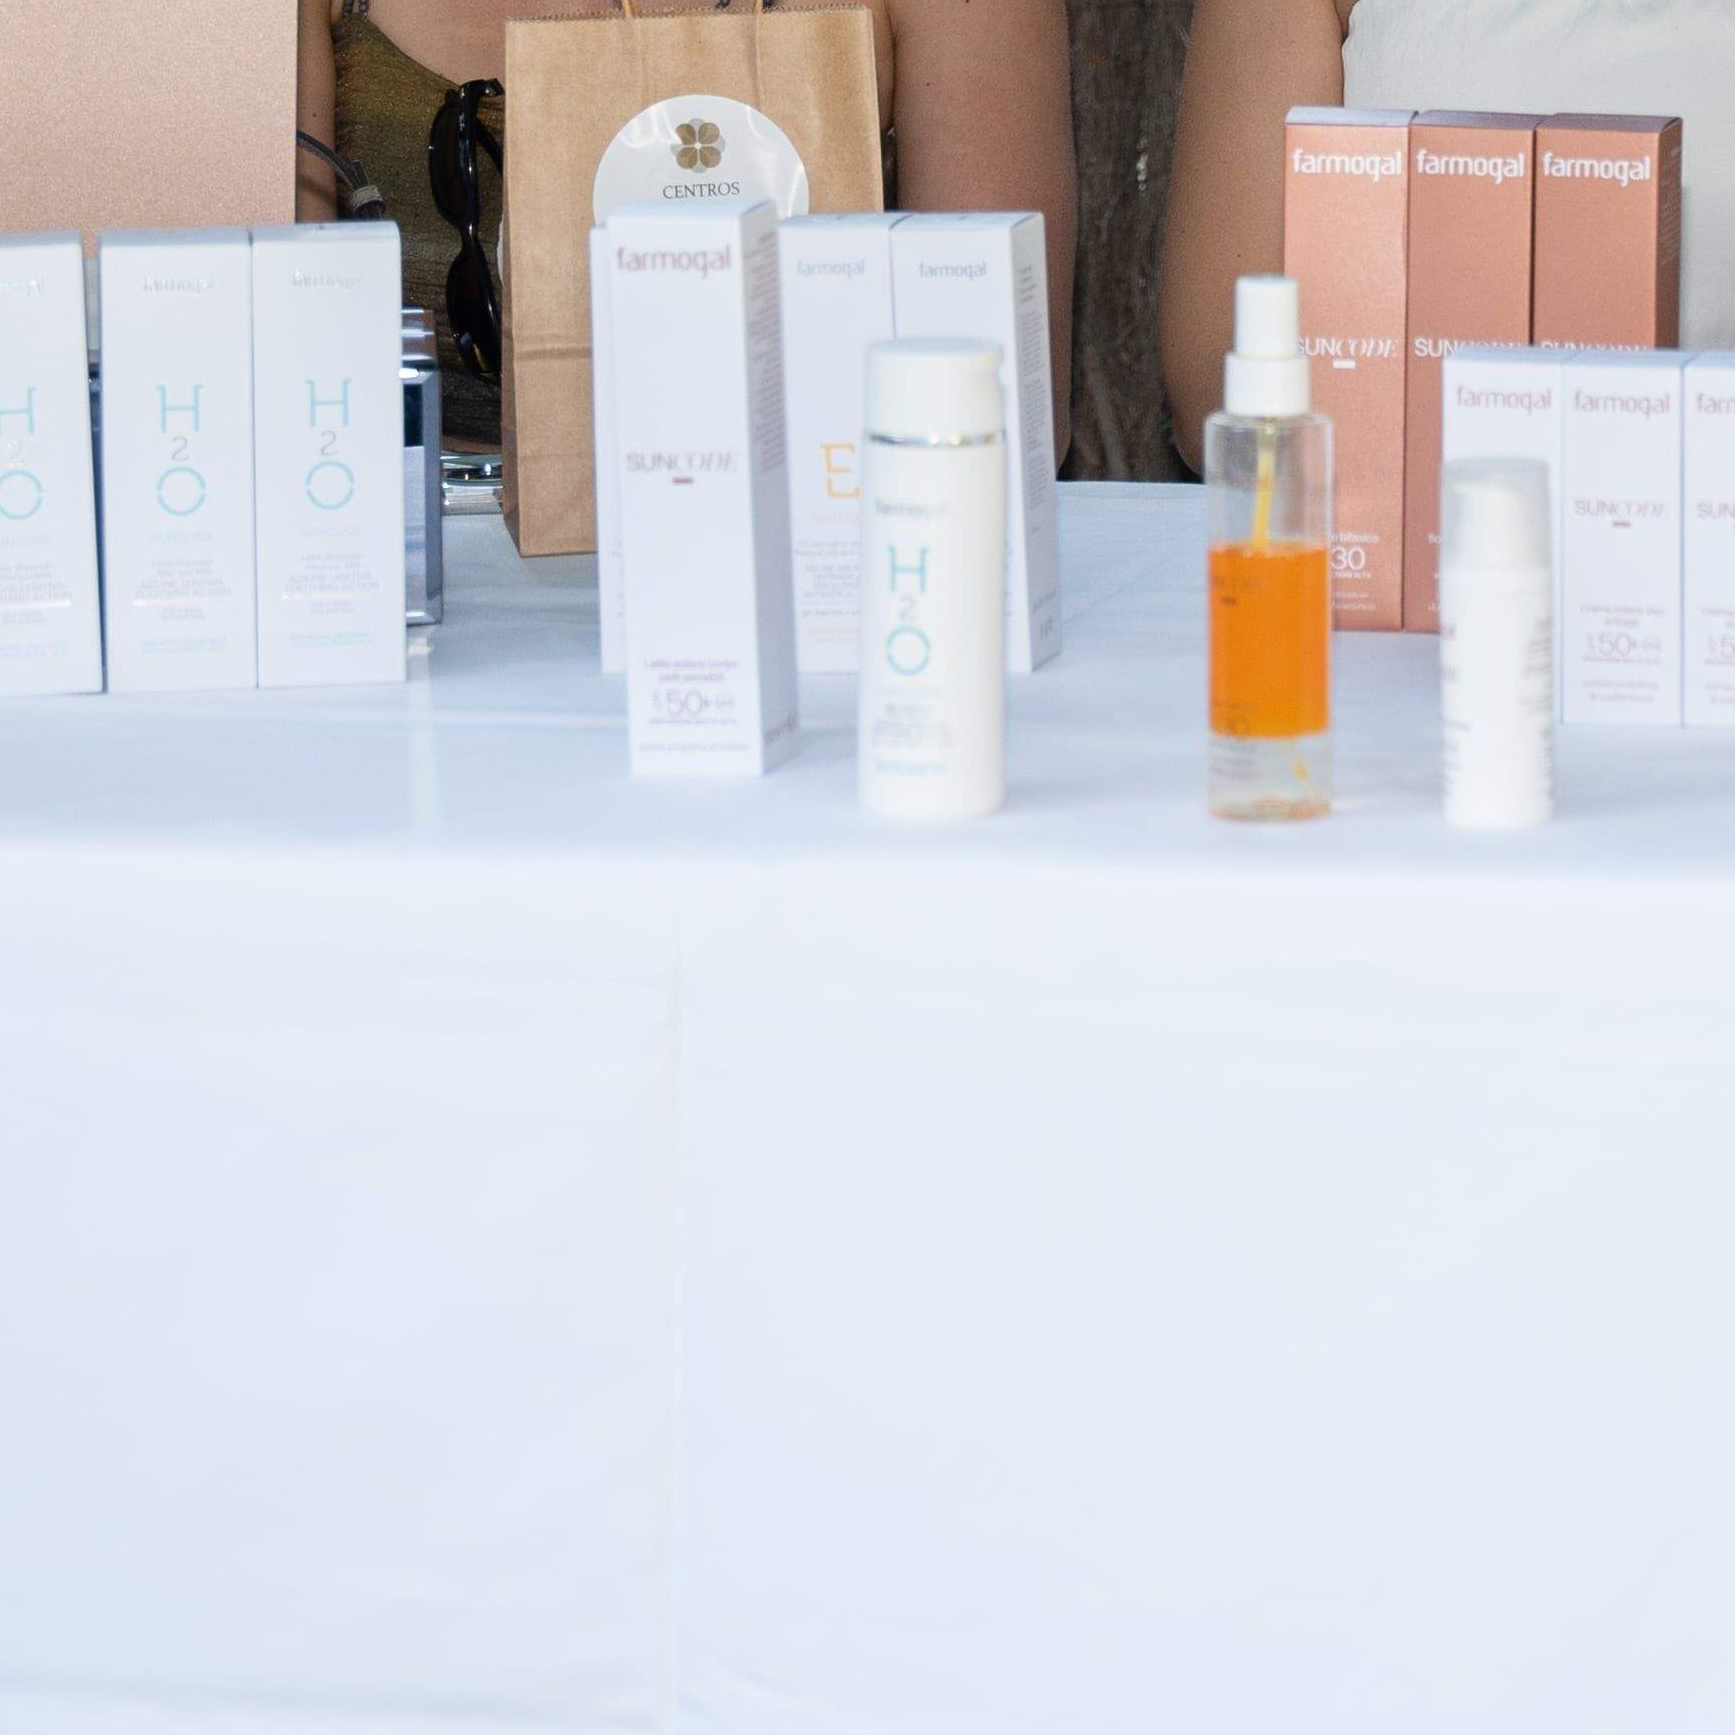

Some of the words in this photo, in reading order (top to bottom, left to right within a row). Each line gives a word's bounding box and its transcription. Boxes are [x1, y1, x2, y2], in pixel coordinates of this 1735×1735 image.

[1292, 148, 1403, 182] farmogal
[1416, 149, 1526, 185] farmogal
[1542, 151, 1652, 187] farmogal
[662, 181, 741, 200] CENTROS
[616, 244, 732, 279] farmogal
[797, 258, 866, 281] farmogal
[918, 260, 987, 281] farmogal
[1455, 384, 1553, 417] farmogal
[1573, 388, 1671, 420] farmogal
